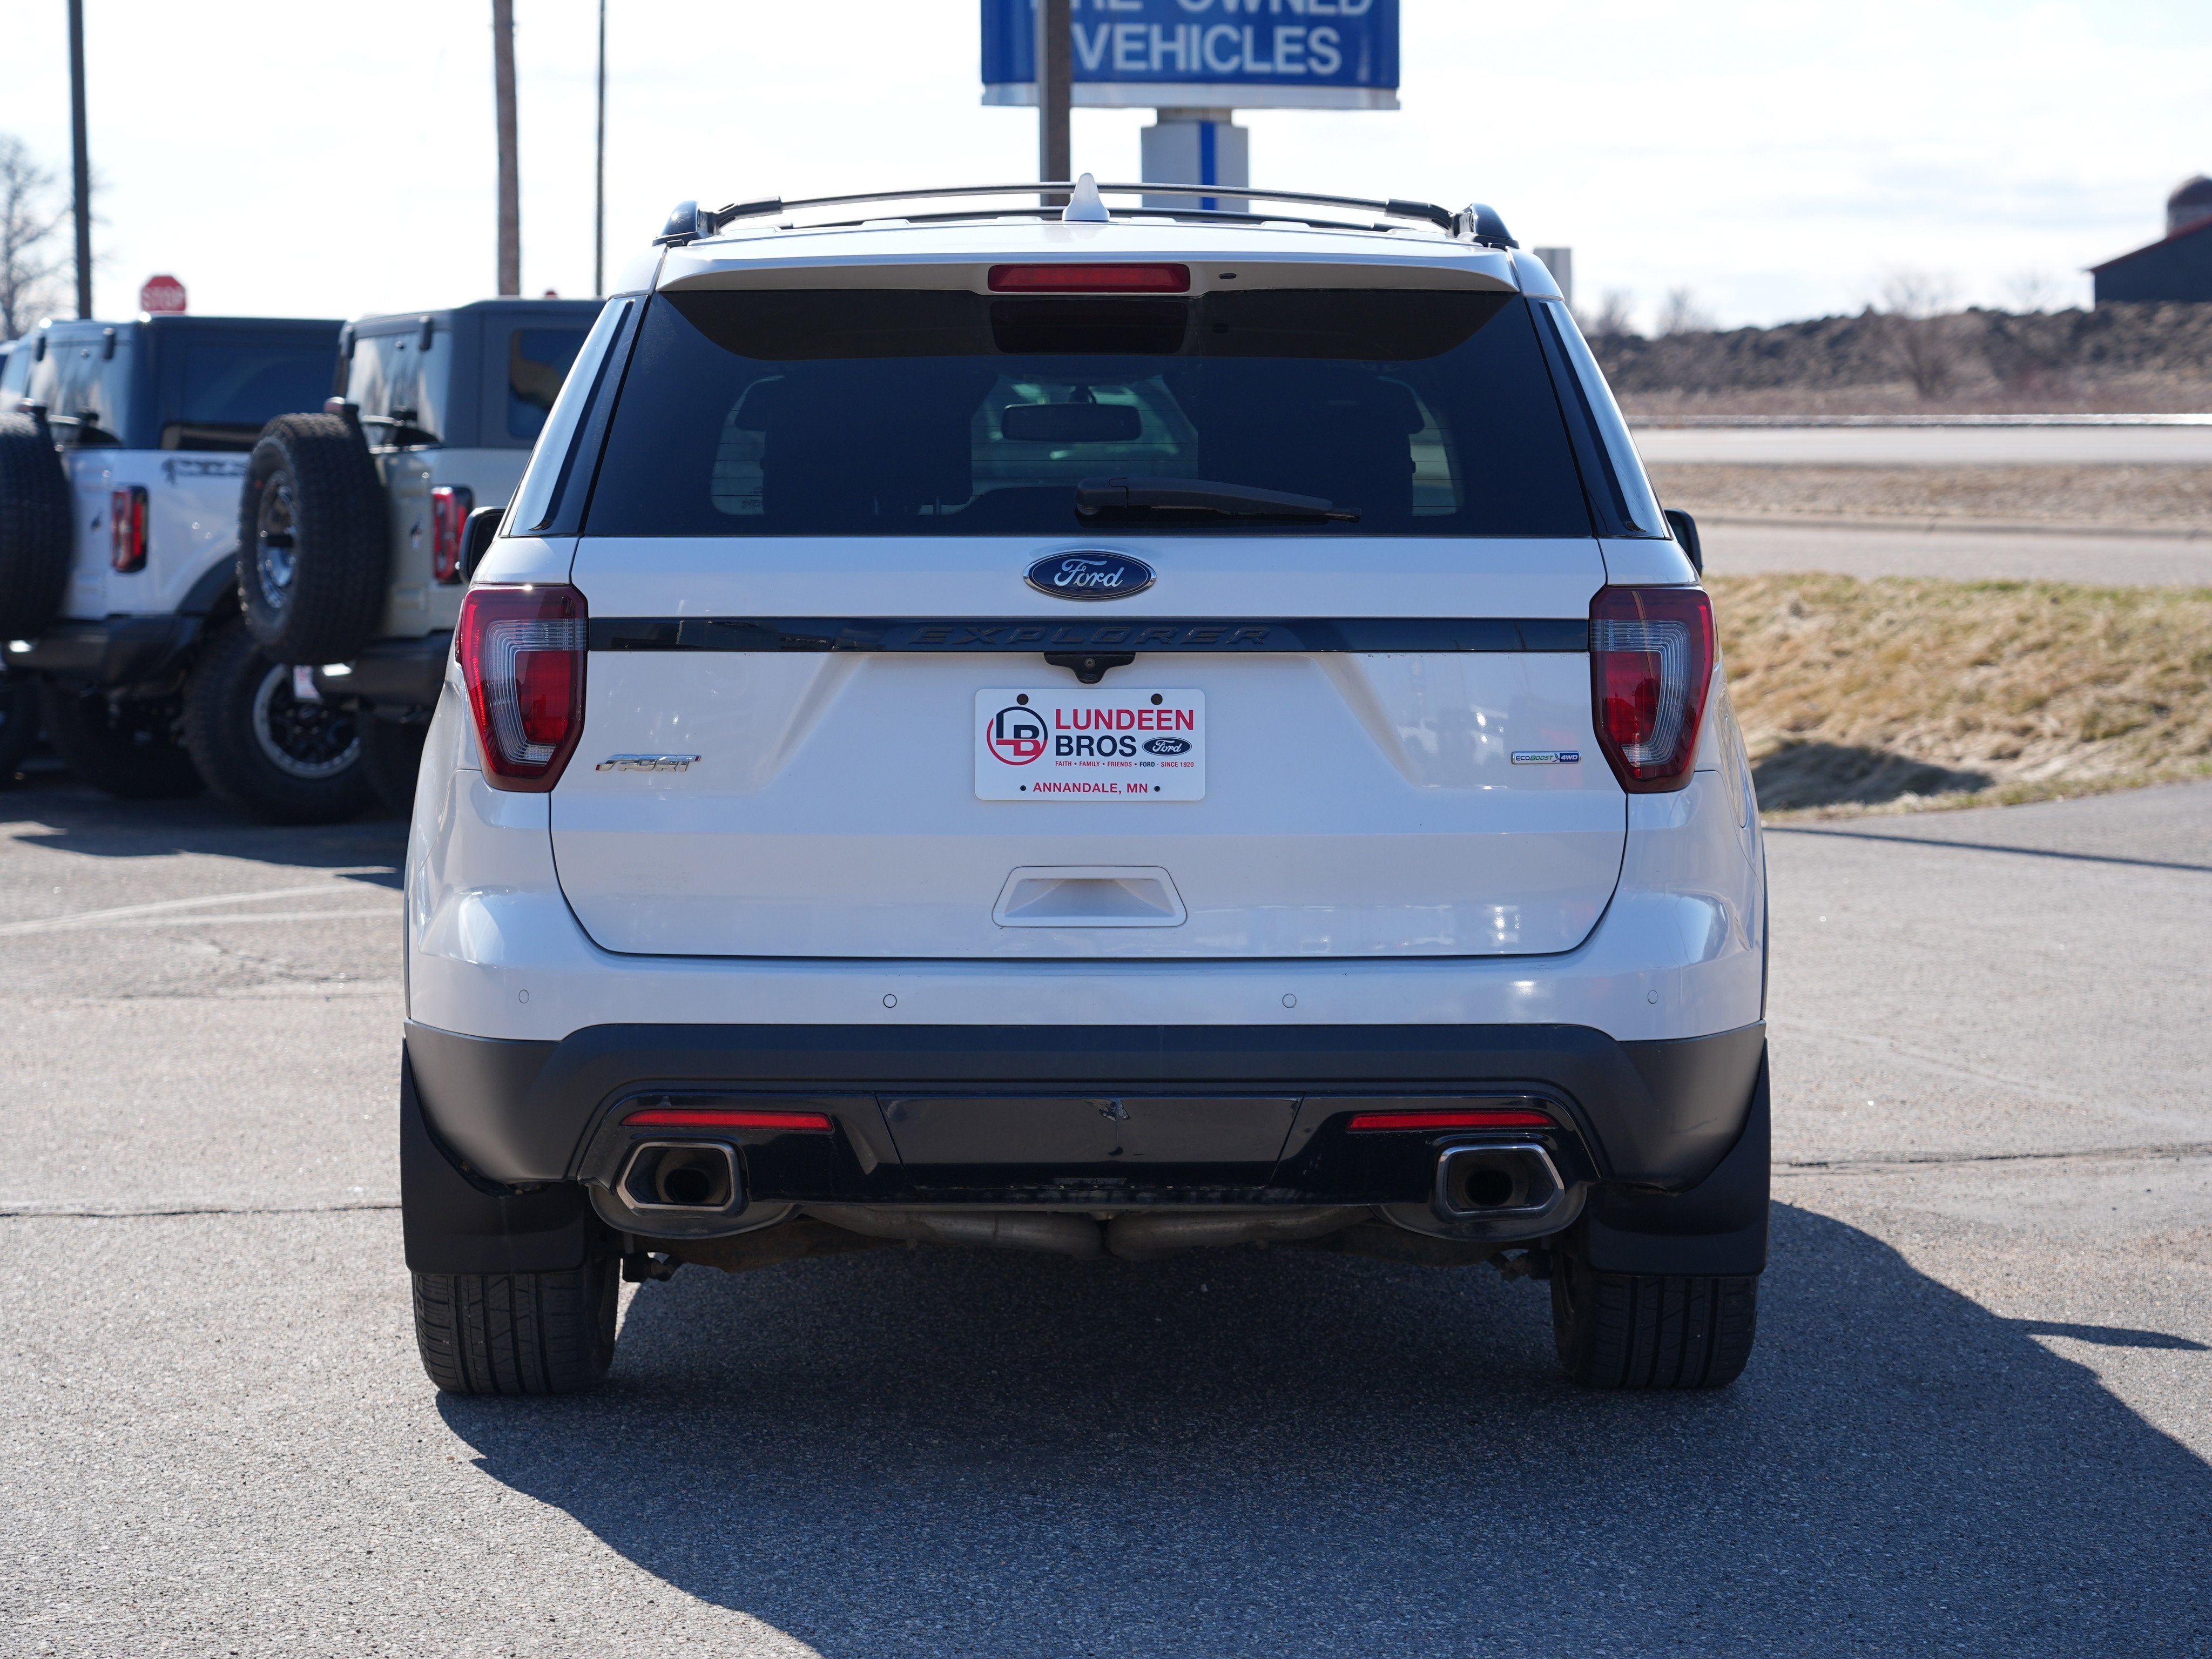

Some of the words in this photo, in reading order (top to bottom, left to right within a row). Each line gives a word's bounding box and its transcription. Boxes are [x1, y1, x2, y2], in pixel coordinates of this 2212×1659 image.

[1070, 23, 1342, 75] VEHICLES
[1054, 558, 1123, 588] Ford
[907, 626, 1271, 645] EXPLORER
[1055, 709, 1194, 731] LUNDEEN
[1055, 735, 1137, 757] BROS
[1152, 739, 1182, 753] Ford
[596, 754, 702, 772] SPORT
[1033, 782, 1122, 795] ANNANDALE,
[1127, 783, 1148, 793] MN
